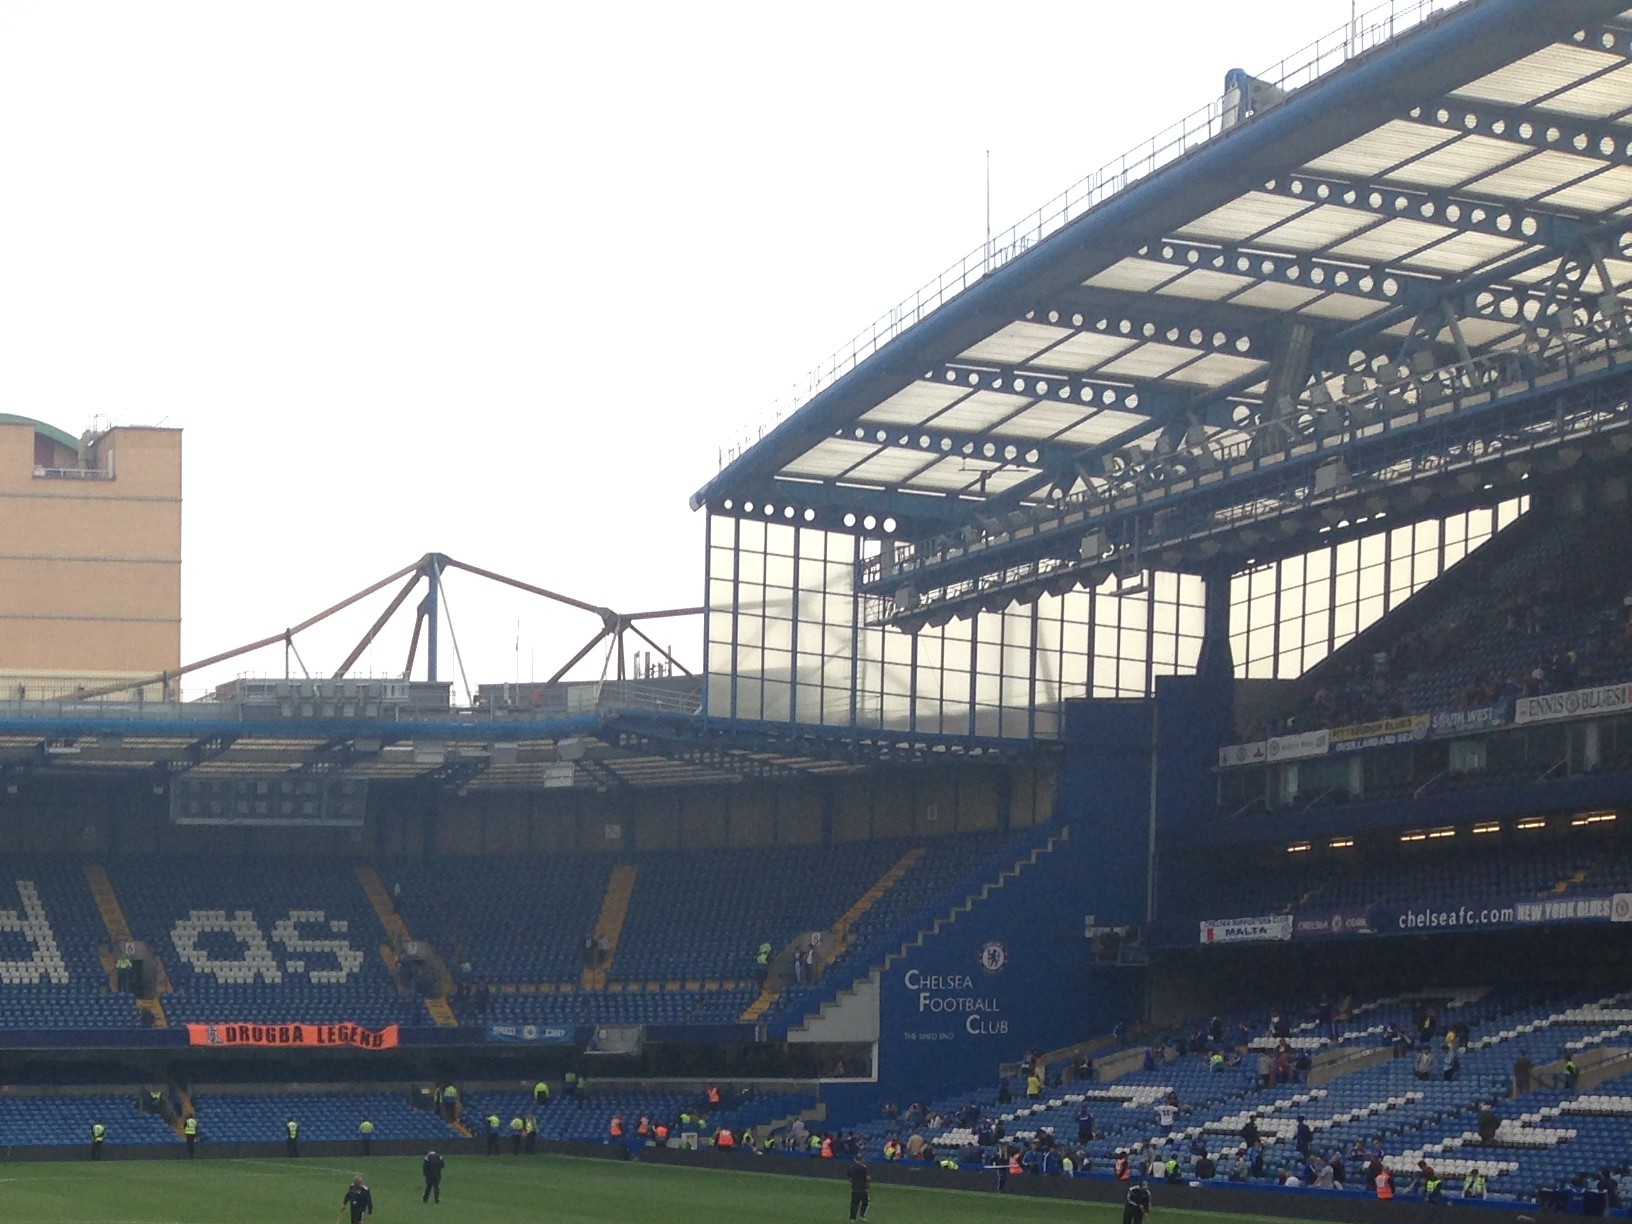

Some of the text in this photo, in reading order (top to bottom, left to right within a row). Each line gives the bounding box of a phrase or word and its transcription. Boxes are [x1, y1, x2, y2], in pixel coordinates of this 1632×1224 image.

[1468, 707, 1493, 722] WEST
[1529, 695, 1564, 717] ENNIS
[1398, 905, 1514, 929] chelseafc.com
[1516, 898, 1611, 921] NEW YORK BLUES
[1225, 926, 1268, 937] MALTA
[904, 969, 974, 990] CHELSEA
[919, 992, 1000, 1012] FOOTBALL
[965, 1014, 1009, 1035] CLUB
[225, 1026, 385, 1048] DROGBA LEGEND
